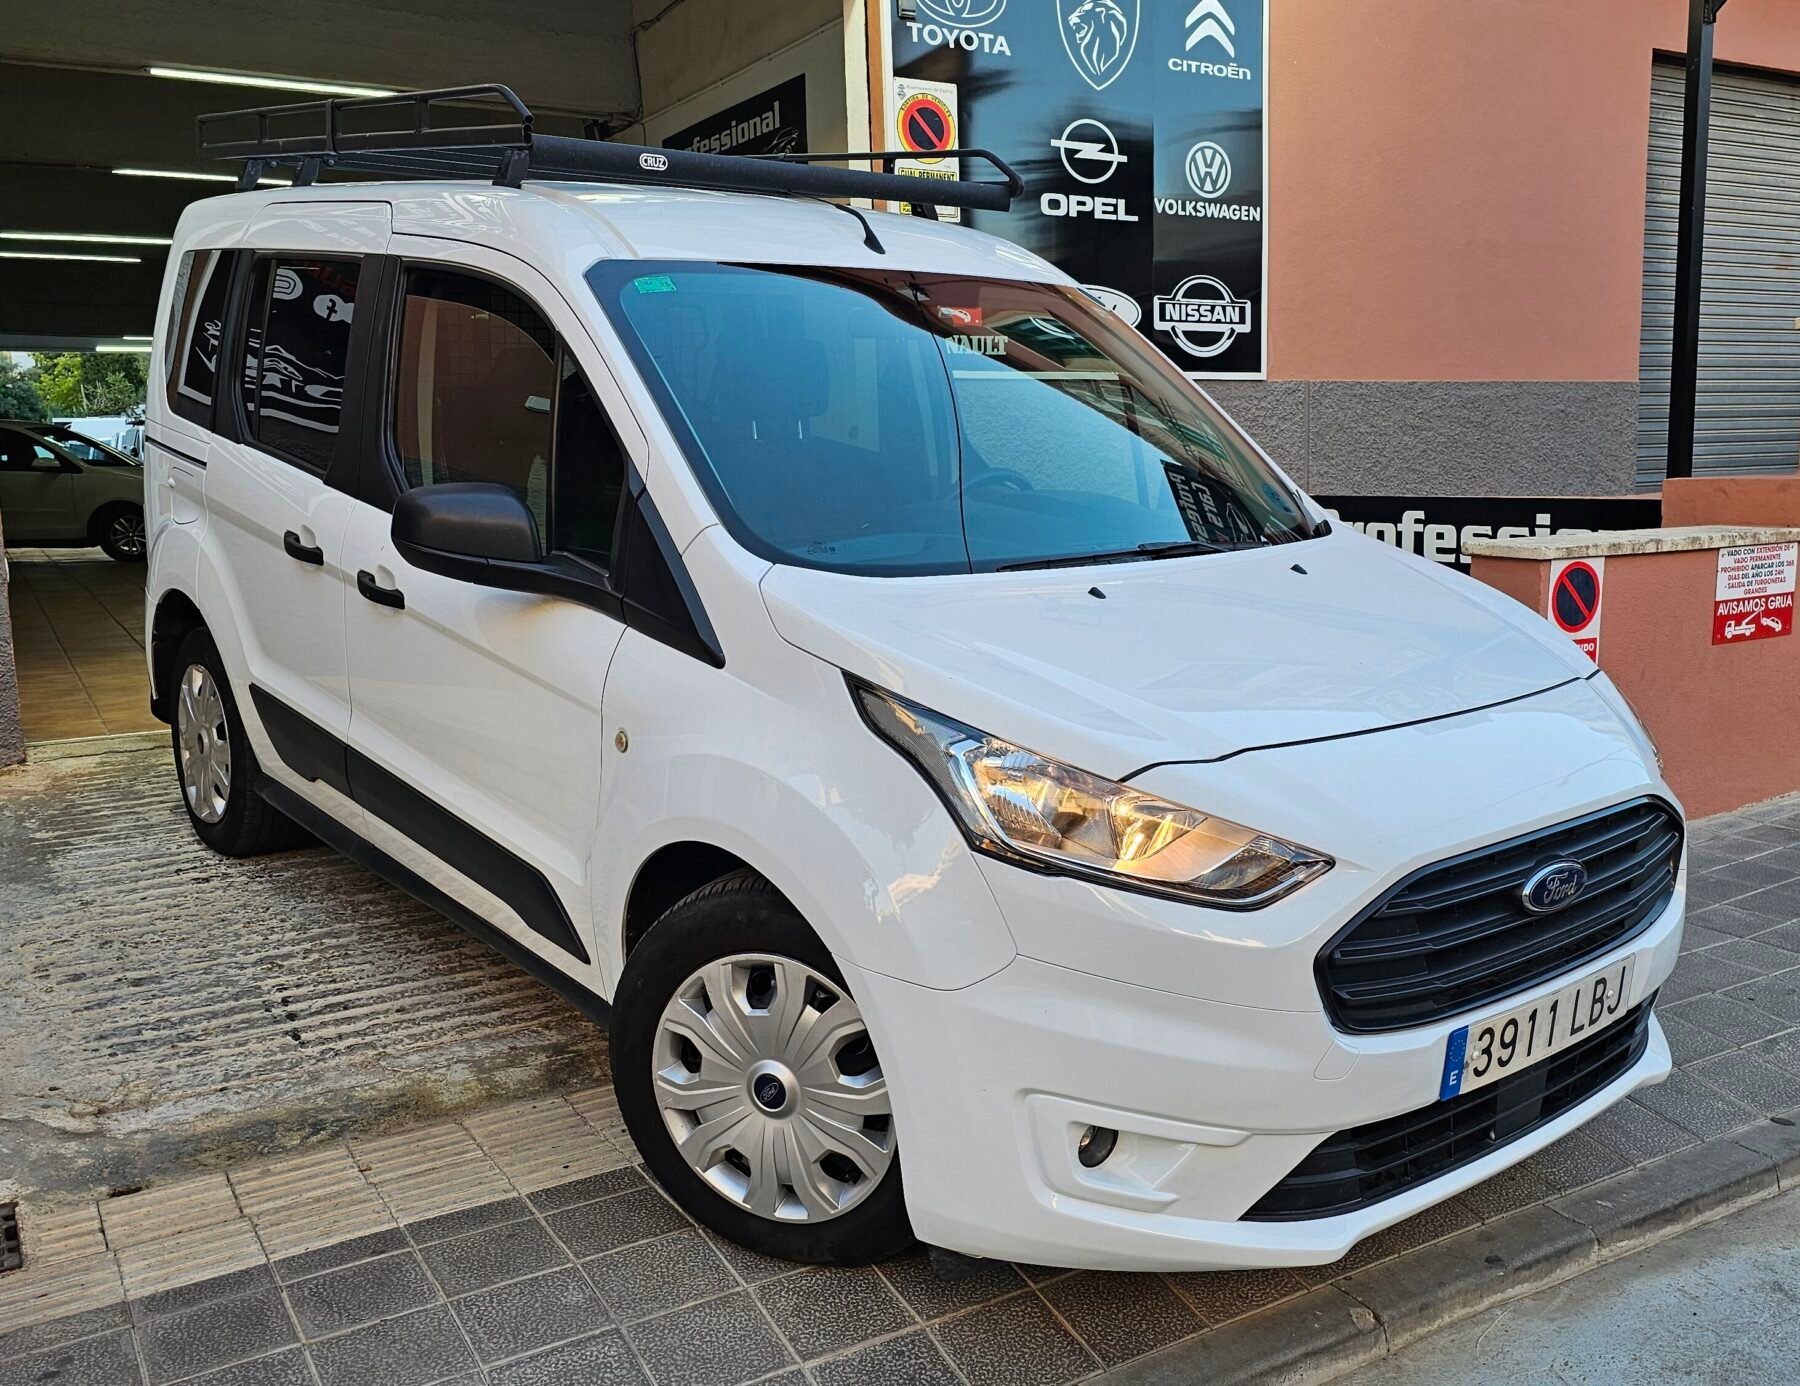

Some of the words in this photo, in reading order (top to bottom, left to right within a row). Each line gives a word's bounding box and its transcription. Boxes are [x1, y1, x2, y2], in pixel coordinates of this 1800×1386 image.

[906, 21, 1012, 56] TOYOTA
[642, 157, 666, 168] CRUZ
[1040, 192, 1139, 222] OPEL
[1154, 197, 1261, 223] VOLKSWAGEN
[1165, 303, 1240, 323] NISSAN
[946, 334, 1008, 356] NAULT
[1727, 549, 1742, 557] VADO
[1749, 553, 1781, 563] PERMANENTE
[1720, 565, 1750, 574] PROHIBIDO
[1751, 562, 1775, 570] APARCAR
[1751, 570, 1763, 578] AÑO
[1727, 581, 1746, 589] SALIDA
[1754, 577, 1786, 586] FURGONETAS
[1743, 587, 1768, 595] GRANDES
[1717, 598, 1765, 616] AVISAMOS
[1768, 594, 1793, 610] GRUA
[1543, 873, 1578, 904] Ford
[1472, 999, 1560, 1078] 3911
[1569, 965, 1627, 1037] LBJ
[1449, 1069, 1459, 1086] E
